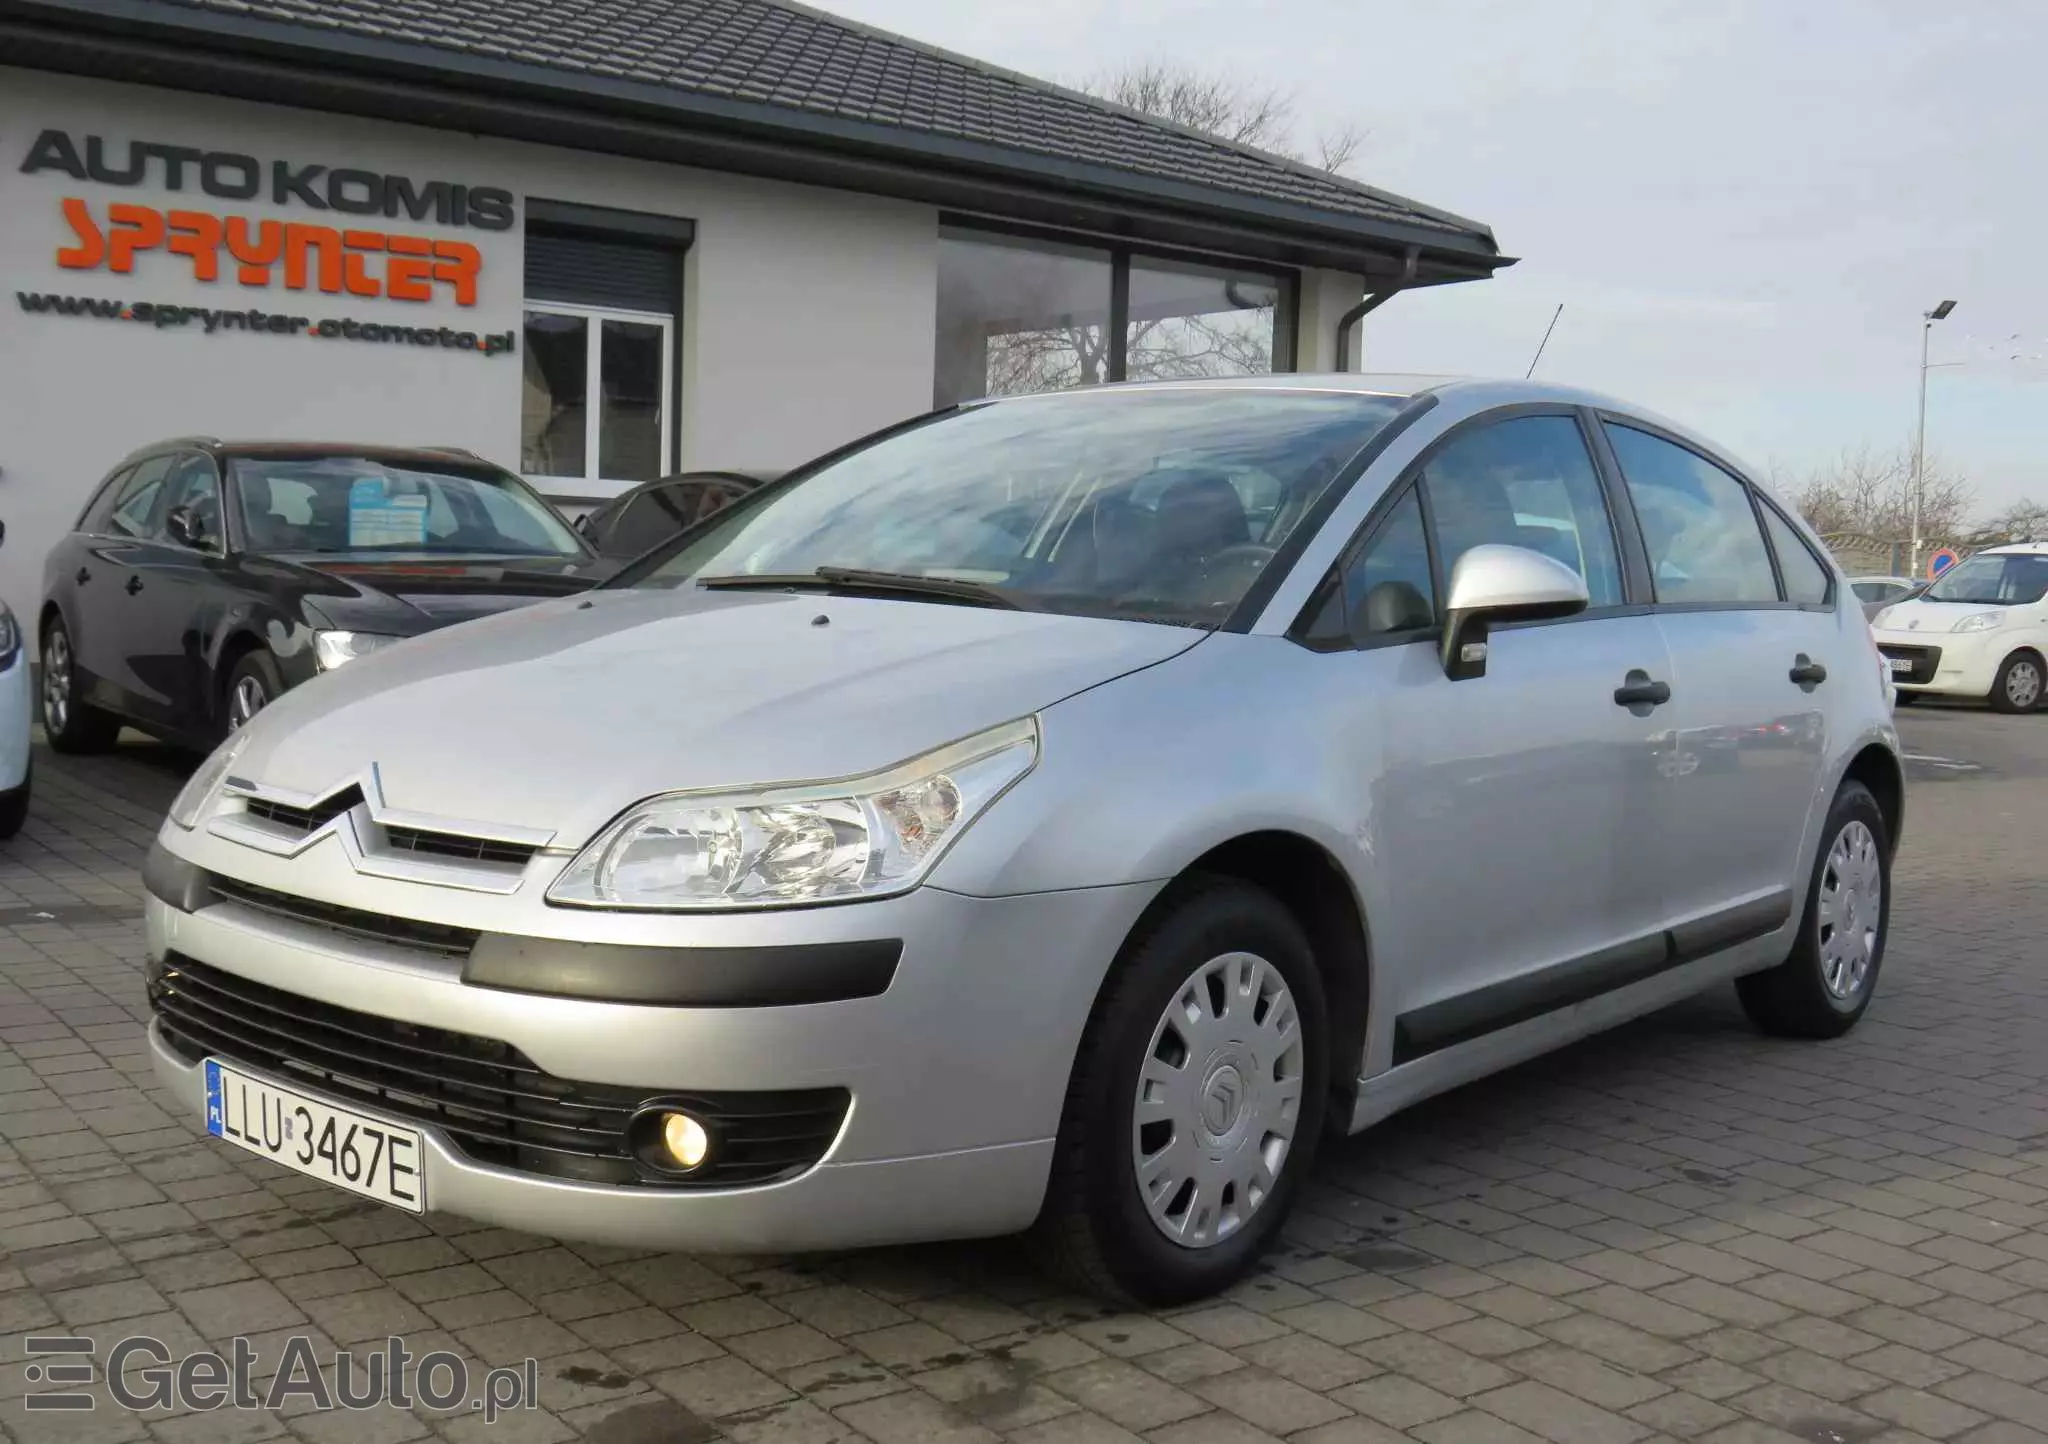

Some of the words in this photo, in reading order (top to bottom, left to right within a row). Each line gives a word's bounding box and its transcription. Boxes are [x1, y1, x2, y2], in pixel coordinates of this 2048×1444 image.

[19, 128, 260, 200] AUTO
[272, 160, 514, 231] KOMIS
[57, 197, 482, 306] SPRYNTER
[16, 291, 515, 357] www.sprynter.otomoto.pl
[210, 1105, 222, 1124] PL
[223, 1076, 283, 1152] LLU
[295, 1106, 415, 1201] 3467E
